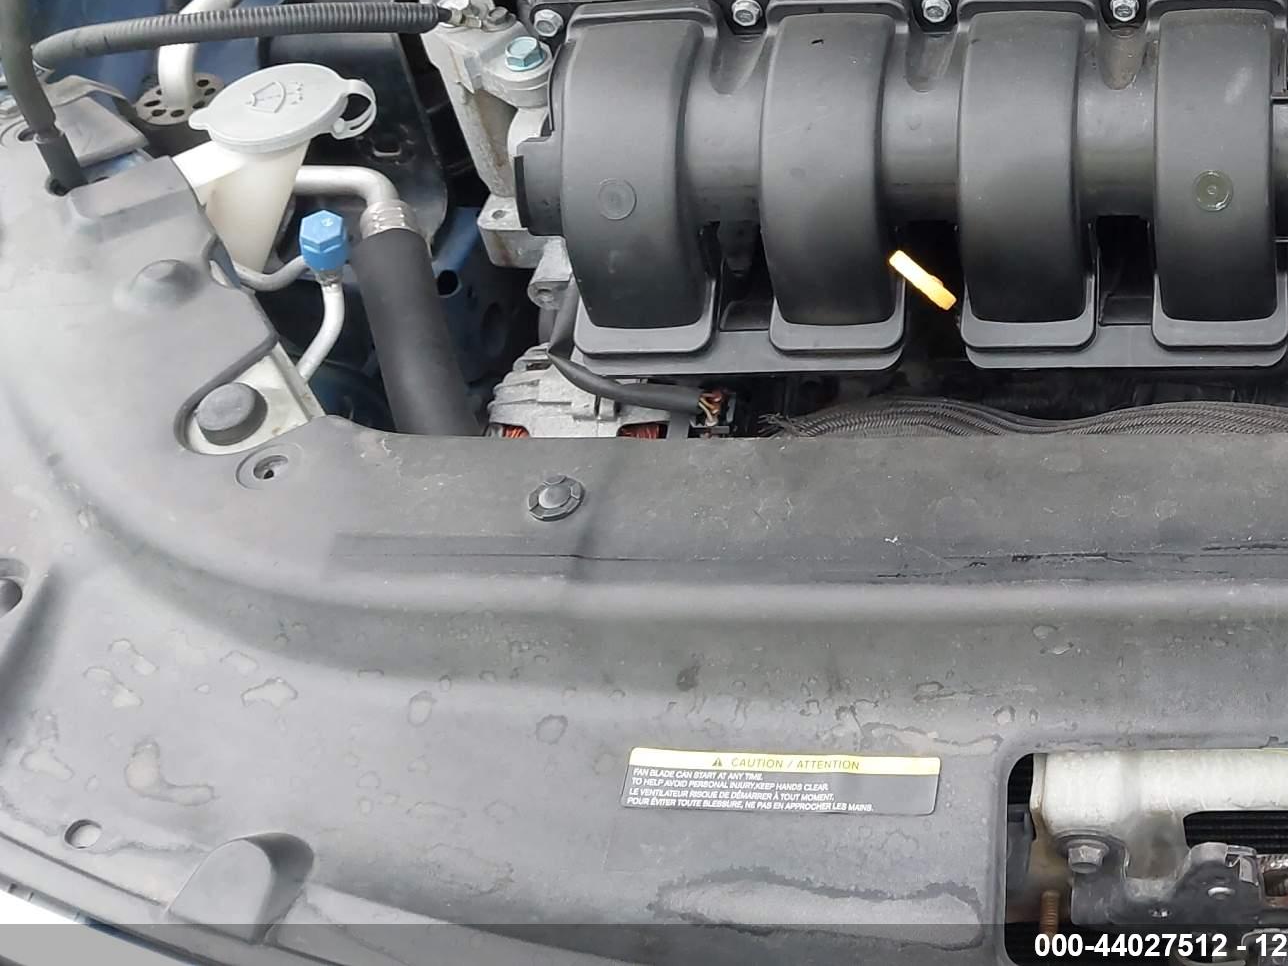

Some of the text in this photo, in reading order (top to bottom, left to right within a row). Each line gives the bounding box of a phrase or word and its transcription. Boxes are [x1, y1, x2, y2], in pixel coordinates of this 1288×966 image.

[731, 757, 783, 768] CAUTION
[797, 760, 860, 770] ATTENTION
[633, 768, 649, 776] FAN
[650, 769, 675, 777] BLADE
[675, 770, 693, 778] CAN
[694, 771, 717, 779] START
[727, 772, 744, 780] ANY
[745, 773, 763, 781] TIME.
[632, 777, 642, 785] TO
[643, 778, 664, 786] HELP
[664, 779, 686, 787] AVOID
[688, 780, 728, 788] PERSONAL
[776, 783, 802, 791] HANDS
[629, 787, 639, 795] LE
[640, 788, 689, 797] VENTILATEUR
[690, 790, 718, 799] RISQUE
[719, 791, 730, 799] DE
[731, 790, 772, 800] DÉMARRER
[773, 791, 779, 800] À
[780, 793, 800, 801] TOUT
[627, 797, 649, 805] POUR
[650, 797, 676, 806] ÉVITER
[677, 799, 701, 807] TOUTE
[744, 801, 755, 809] NE
[785, 803, 831, 811] APPROCHER
[847, 804, 874, 812] MAINS.
